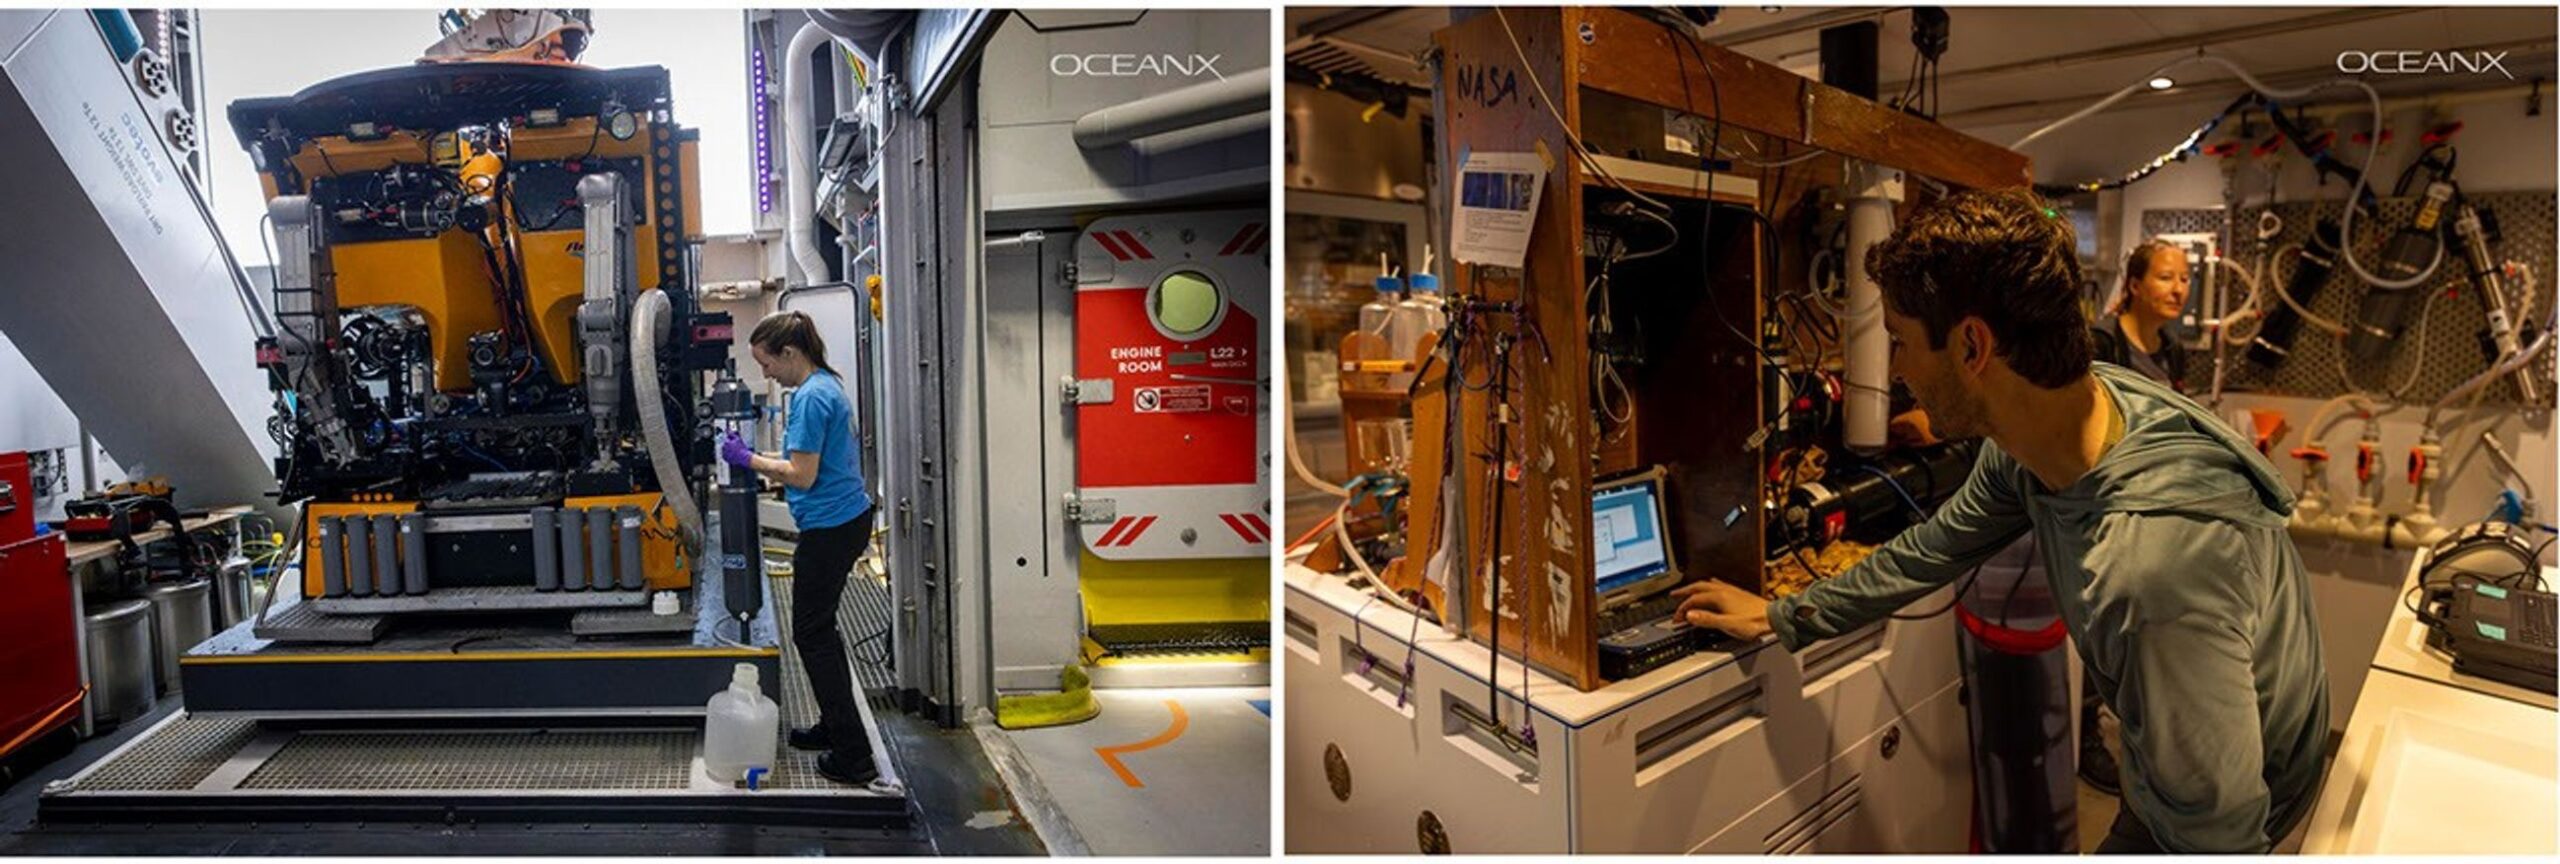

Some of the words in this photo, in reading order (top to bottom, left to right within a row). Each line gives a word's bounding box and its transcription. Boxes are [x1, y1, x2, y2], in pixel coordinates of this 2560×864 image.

[1457, 64, 1518, 107] NASA
[97, 132, 125, 171] WEIGHT
[1111, 346, 1162, 359] ENGINE
[1210, 347, 1235, 359] L22
[1119, 361, 1162, 373] ROOM
